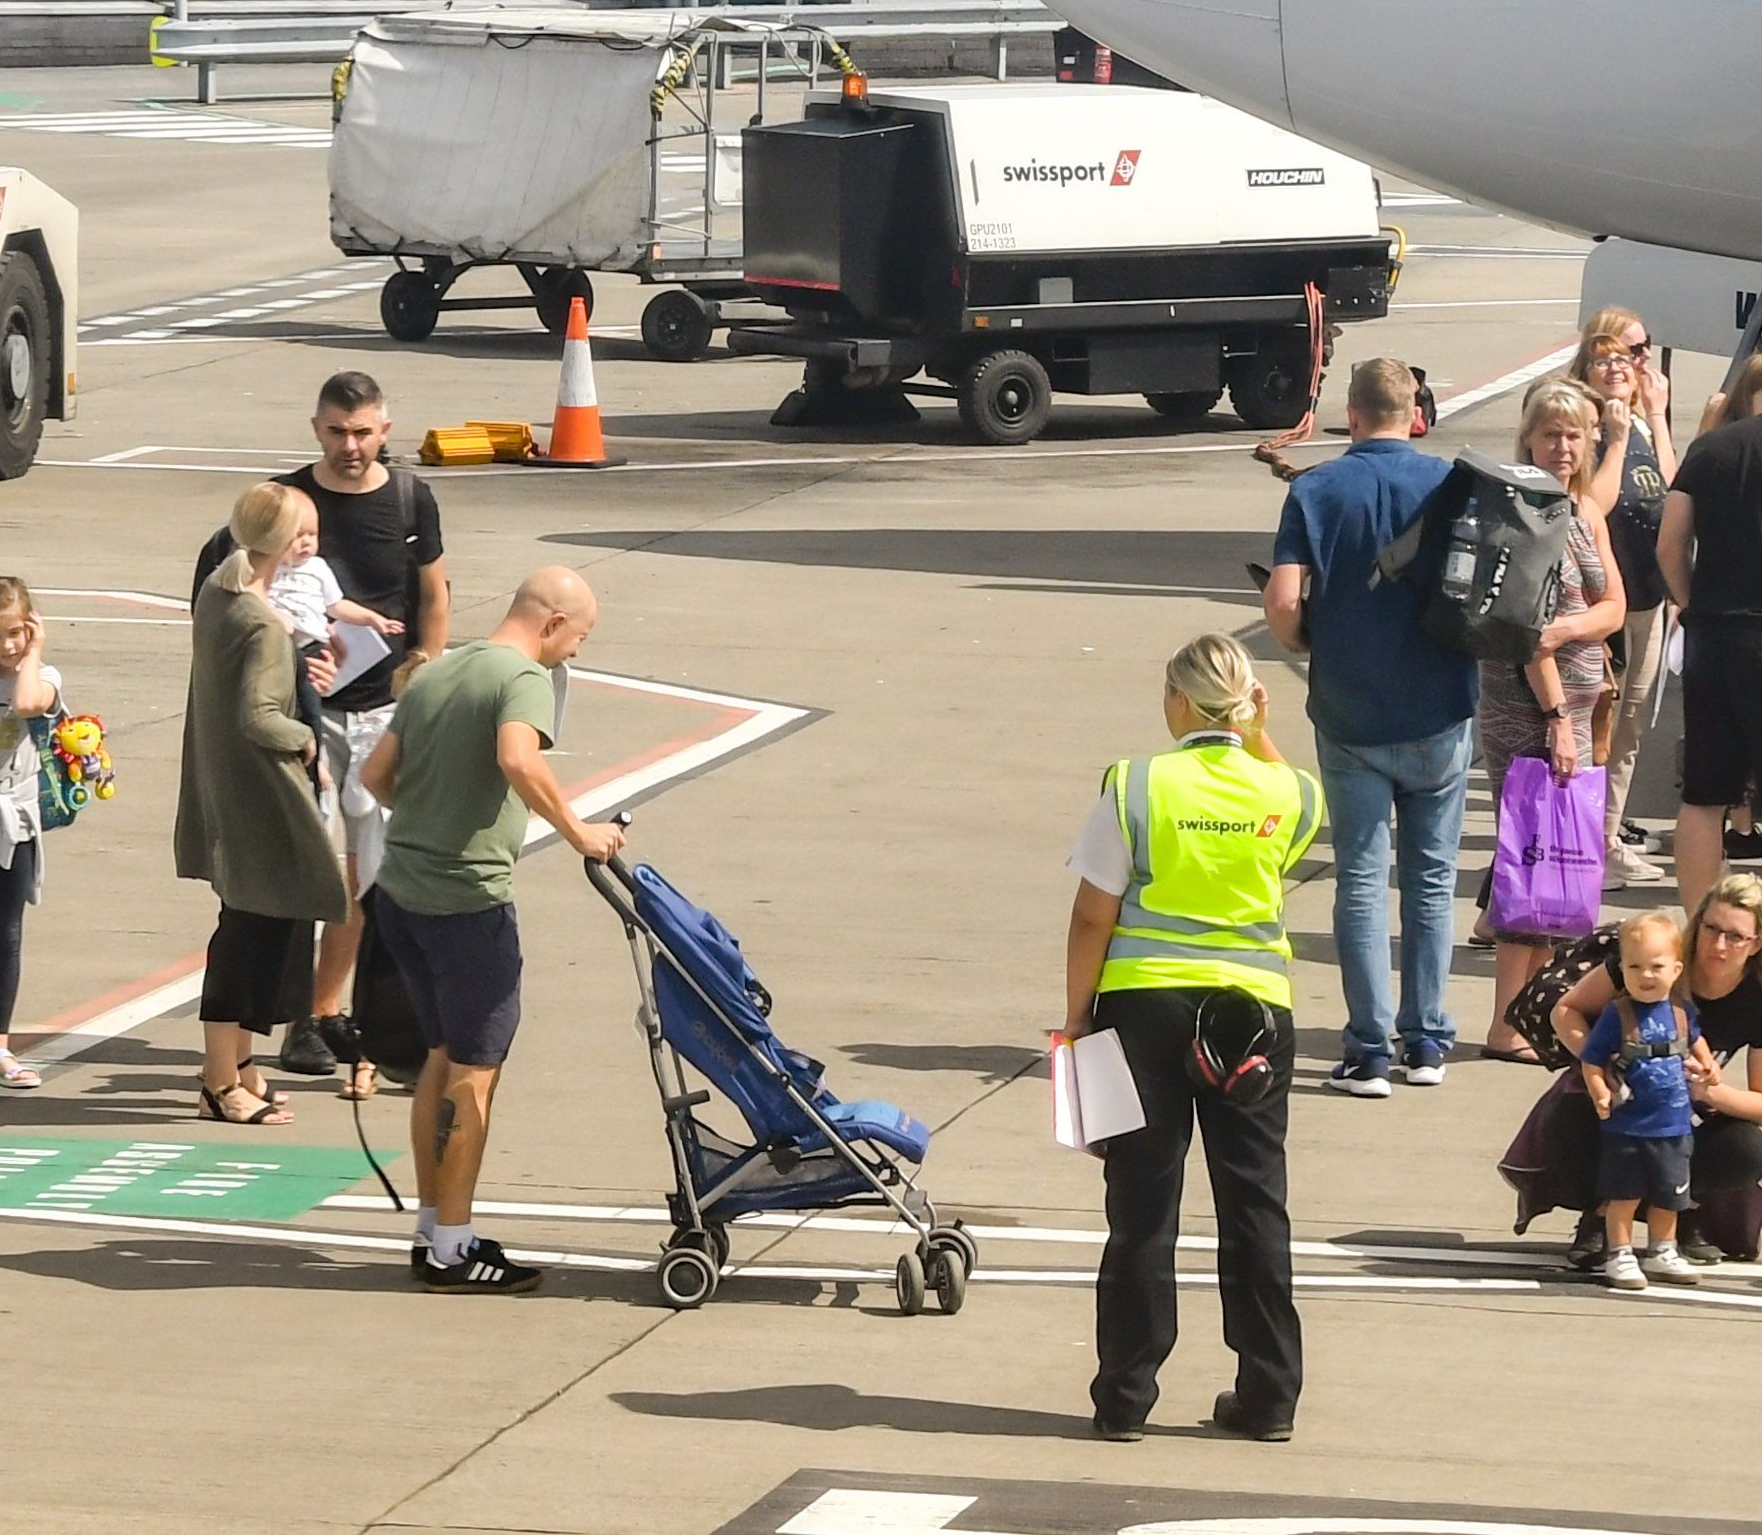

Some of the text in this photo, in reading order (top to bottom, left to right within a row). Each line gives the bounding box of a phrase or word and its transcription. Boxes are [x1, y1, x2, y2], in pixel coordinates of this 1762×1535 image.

[1003, 157, 1106, 188] swissport
[1250, 170, 1323, 185] HOUCHIN
[969, 222, 1013, 236] GPU2101
[970, 236, 1017, 251] 214-1323
[1177, 815, 1256, 836] swissport
[25, 1142, 196, 1210] ASSEMBLY
[160, 1160, 282, 1197] FIRE
